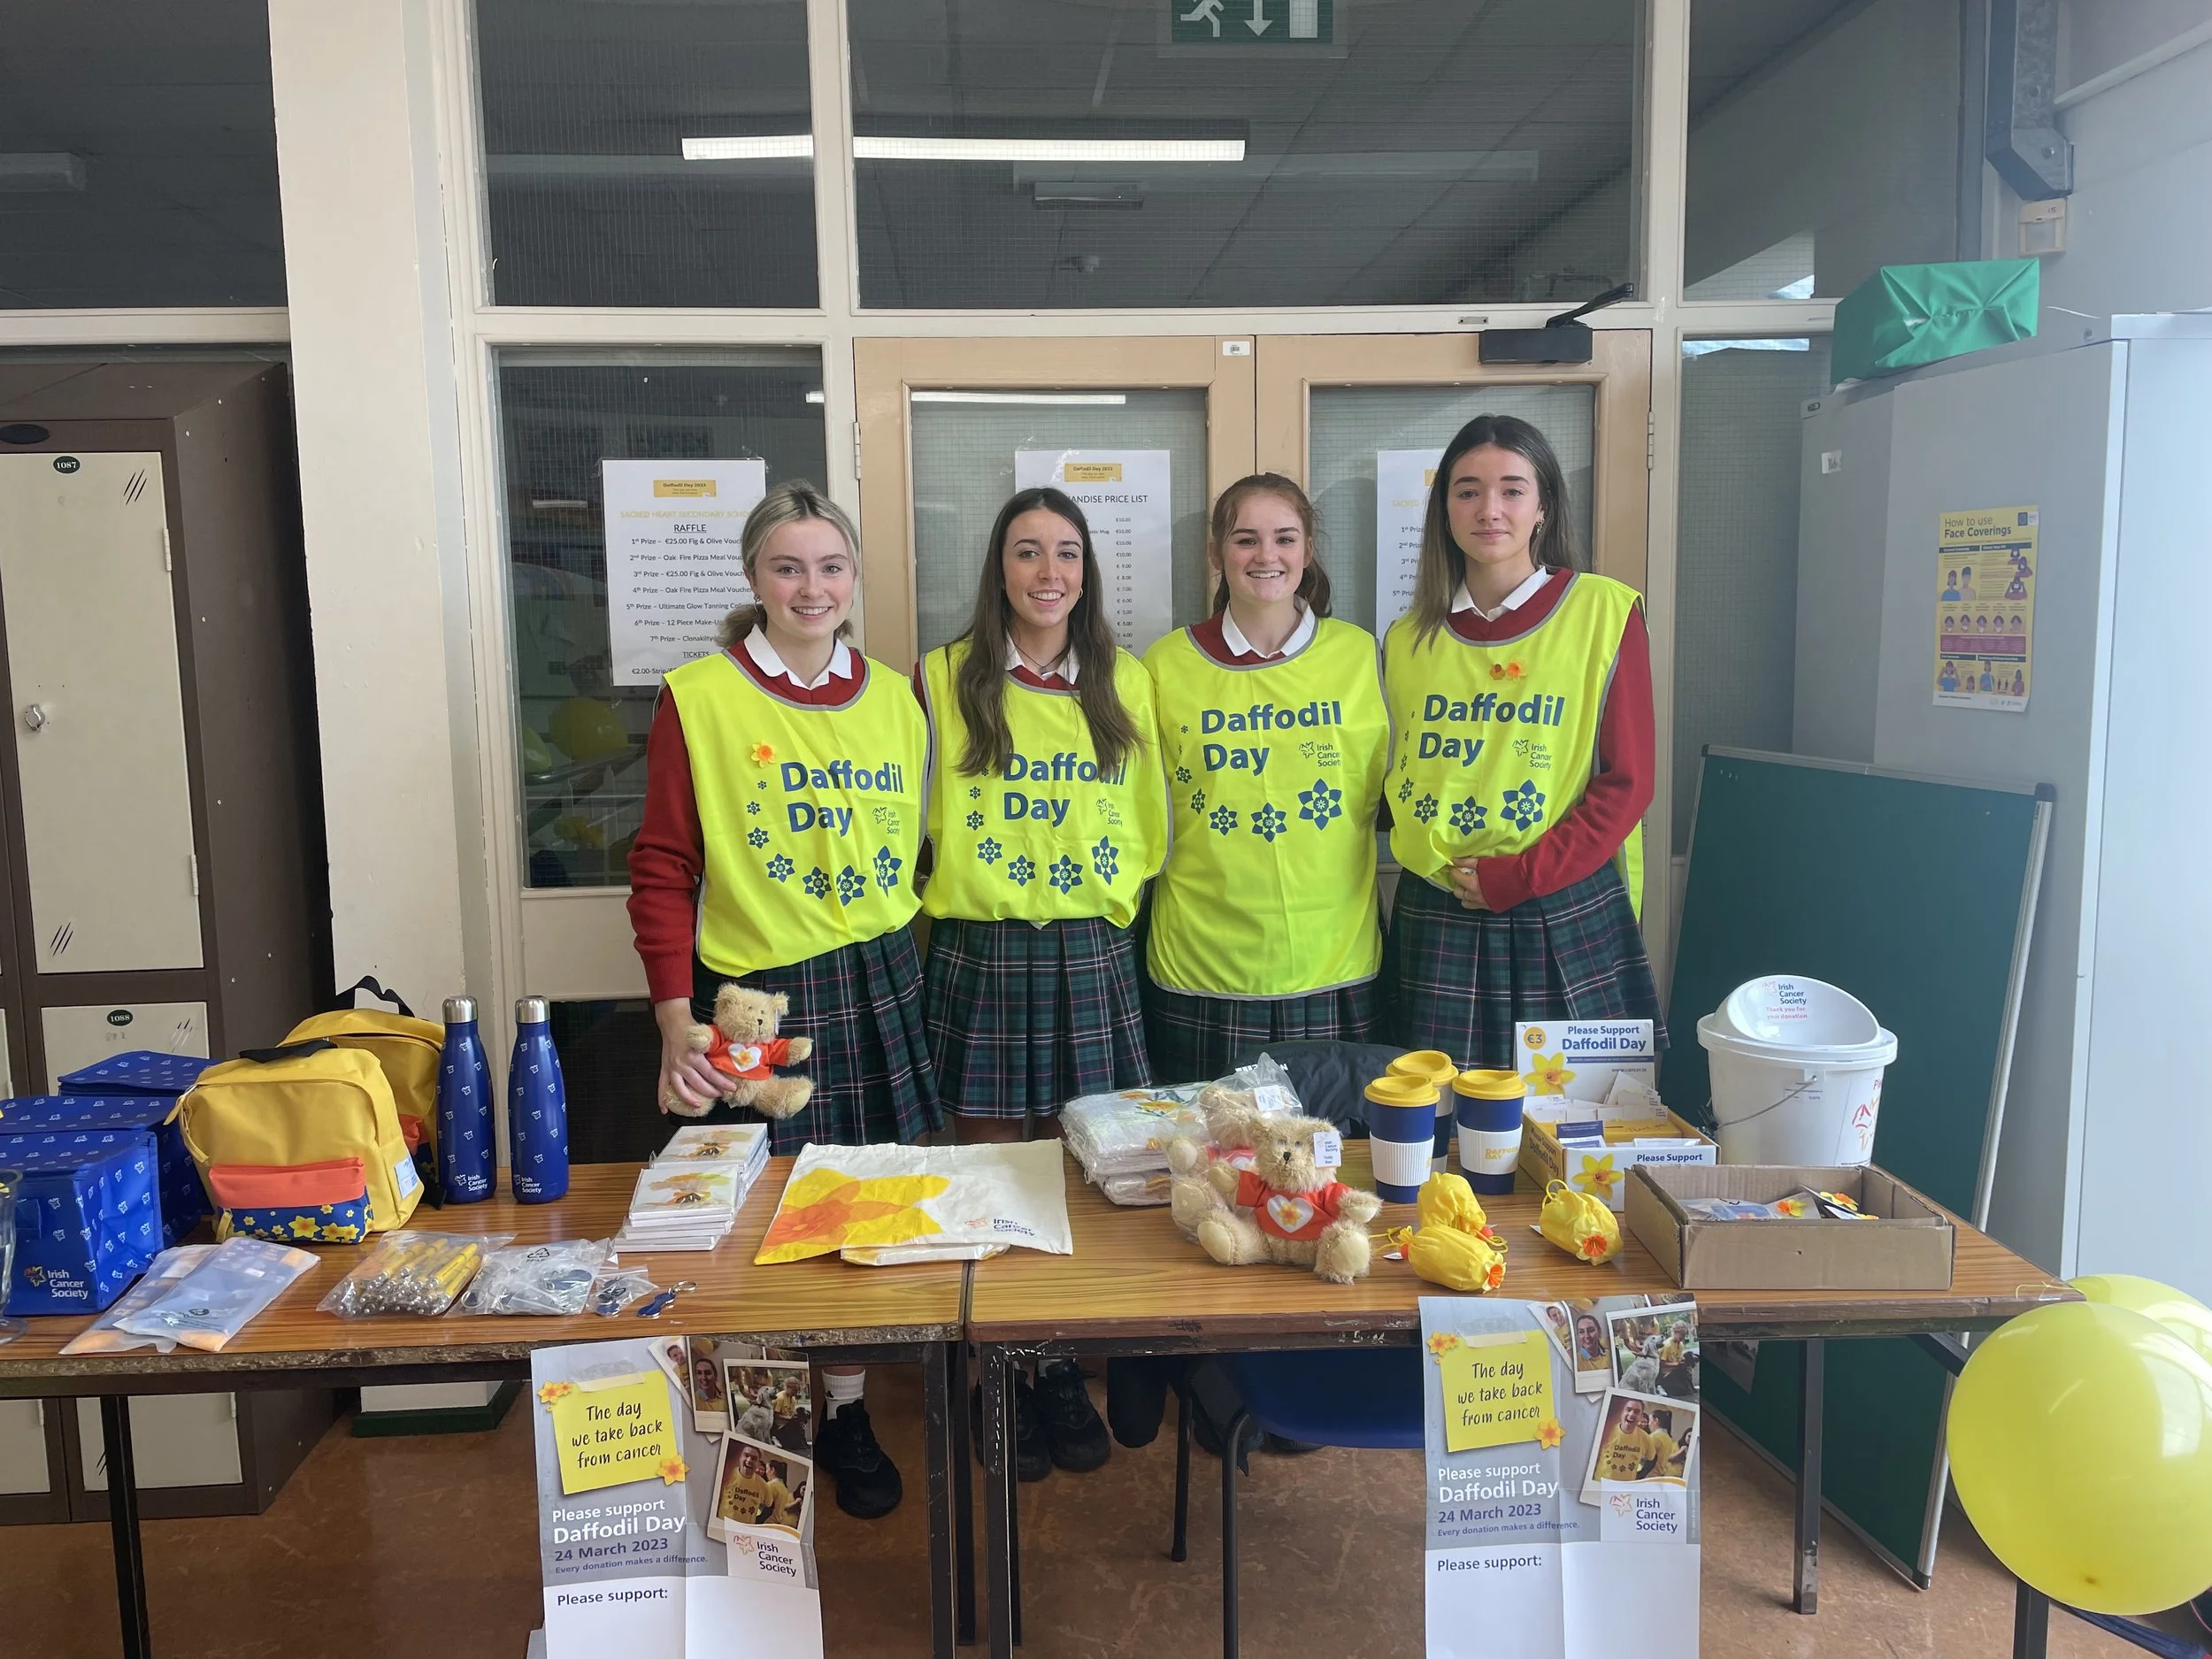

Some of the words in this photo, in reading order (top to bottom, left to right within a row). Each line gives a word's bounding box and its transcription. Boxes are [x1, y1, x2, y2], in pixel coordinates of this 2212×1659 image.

[1945, 518, 1963, 528] How
[1967, 517, 1975, 526] to
[1978, 517, 1993, 526] use
[1945, 529, 1964, 538] Face
[1968, 526, 2011, 537] Coverings
[1202, 701, 1341, 734] Daffodil
[1424, 693, 1564, 726] Daffodil
[1418, 732, 1485, 767] Day
[1202, 743, 1270, 776] Day
[780, 760, 904, 794] Daffodil
[1004, 792, 1071, 827] Day
[787, 802, 853, 837] Day
[1527, 1034, 1542, 1044] €3
[1568, 1026, 1599, 1035] Please
[1601, 1025, 1640, 1035] Support
[1562, 1038, 1617, 1050] Daffodil
[1619, 1038, 1647, 1052] Day
[1637, 1154, 1664, 1163] Please
[1667, 1154, 1702, 1163] Support
[50, 1279, 84, 1288] Cancer
[51, 1288, 88, 1300] Society
[1472, 1363, 1495, 1379] The
[1501, 1361, 1524, 1379] day
[1458, 1394, 1474, 1404] we
[1479, 1387, 1506, 1402] take
[1511, 1381, 1542, 1397] back
[586, 1406, 611, 1421] The
[617, 1402, 641, 1419] day
[1462, 1409, 1492, 1426] from
[1497, 1406, 1540, 1422] cancer
[572, 1433, 590, 1447] we
[595, 1427, 624, 1443] take
[630, 1419, 662, 1437] back
[577, 1451, 610, 1469] from
[616, 1444, 661, 1462] cancer
[1438, 1467, 1481, 1481] Please
[1486, 1463, 1540, 1479] support
[734, 1494, 746, 1502] Day
[1440, 1479, 1516, 1503] Daffodil
[1522, 1479, 1558, 1499] Day
[552, 1509, 601, 1523] Please
[605, 1499, 665, 1517] support
[1636, 1498, 1660, 1508] Irish
[1439, 1510, 1455, 1524] 24
[1460, 1506, 1503, 1522] March
[1508, 1503, 1541, 1517] 2023
[1636, 1509, 1676, 1520] Cancer
[554, 1517, 638, 1544] Daffodil
[646, 1516, 686, 1533] Day
[1462, 1525, 1499, 1535] donation
[1501, 1523, 1527, 1532] makes
[1536, 1521, 1579, 1530] difference.
[1636, 1520, 1678, 1533] Society
[555, 1549, 573, 1562] 24
[579, 1543, 626, 1559] March
[632, 1538, 668, 1552] 2023
[757, 1541, 779, 1553] Irish
[582, 1558, 622, 1571] donation
[626, 1557, 653, 1566] makes
[663, 1555, 708, 1563] difference.
[759, 1551, 793, 1564] Cancer
[1438, 1559, 1480, 1571] Please
[1484, 1555, 1542, 1570] support:
[760, 1561, 796, 1577] Society
[557, 1594, 603, 1606] Please
[608, 1587, 668, 1602] support:
